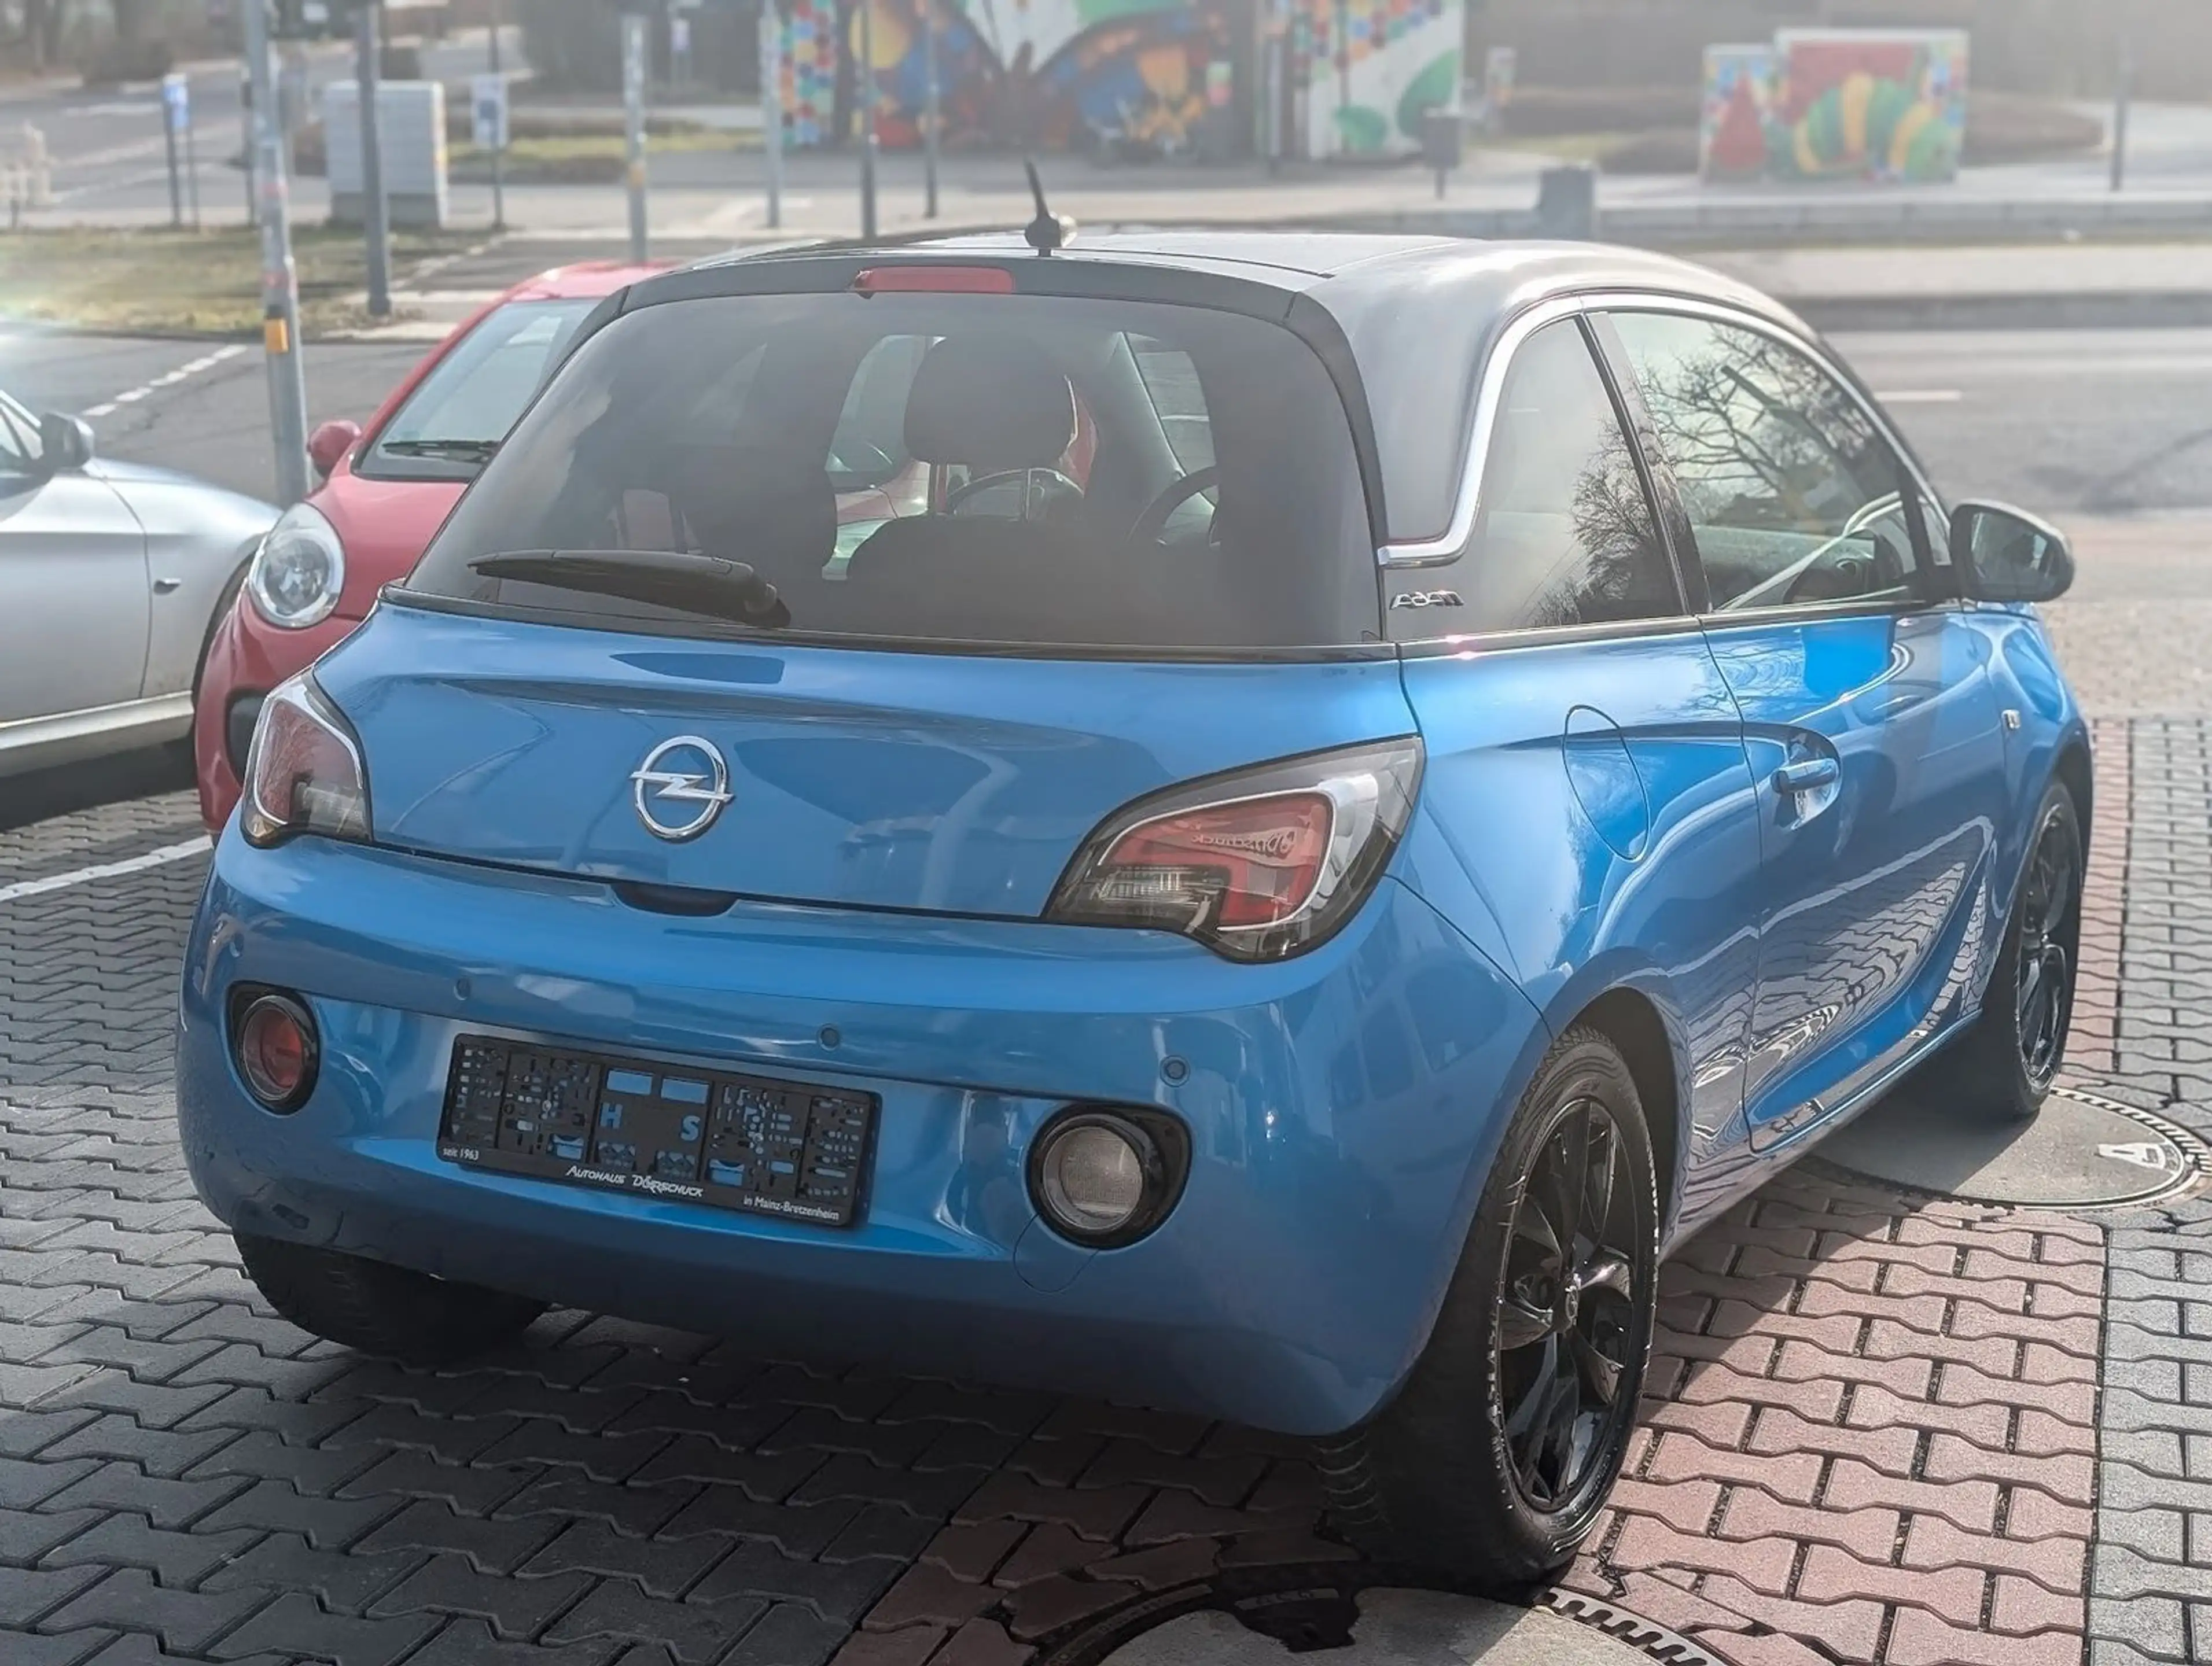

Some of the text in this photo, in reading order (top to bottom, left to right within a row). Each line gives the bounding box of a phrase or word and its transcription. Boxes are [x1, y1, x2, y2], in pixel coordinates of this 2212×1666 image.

[600, 1102, 623, 1129] H
[680, 1115, 701, 1141] S
[459, 1148, 479, 1160] 1963
[743, 1194, 840, 1221] in Mainz-Bretzenheim
